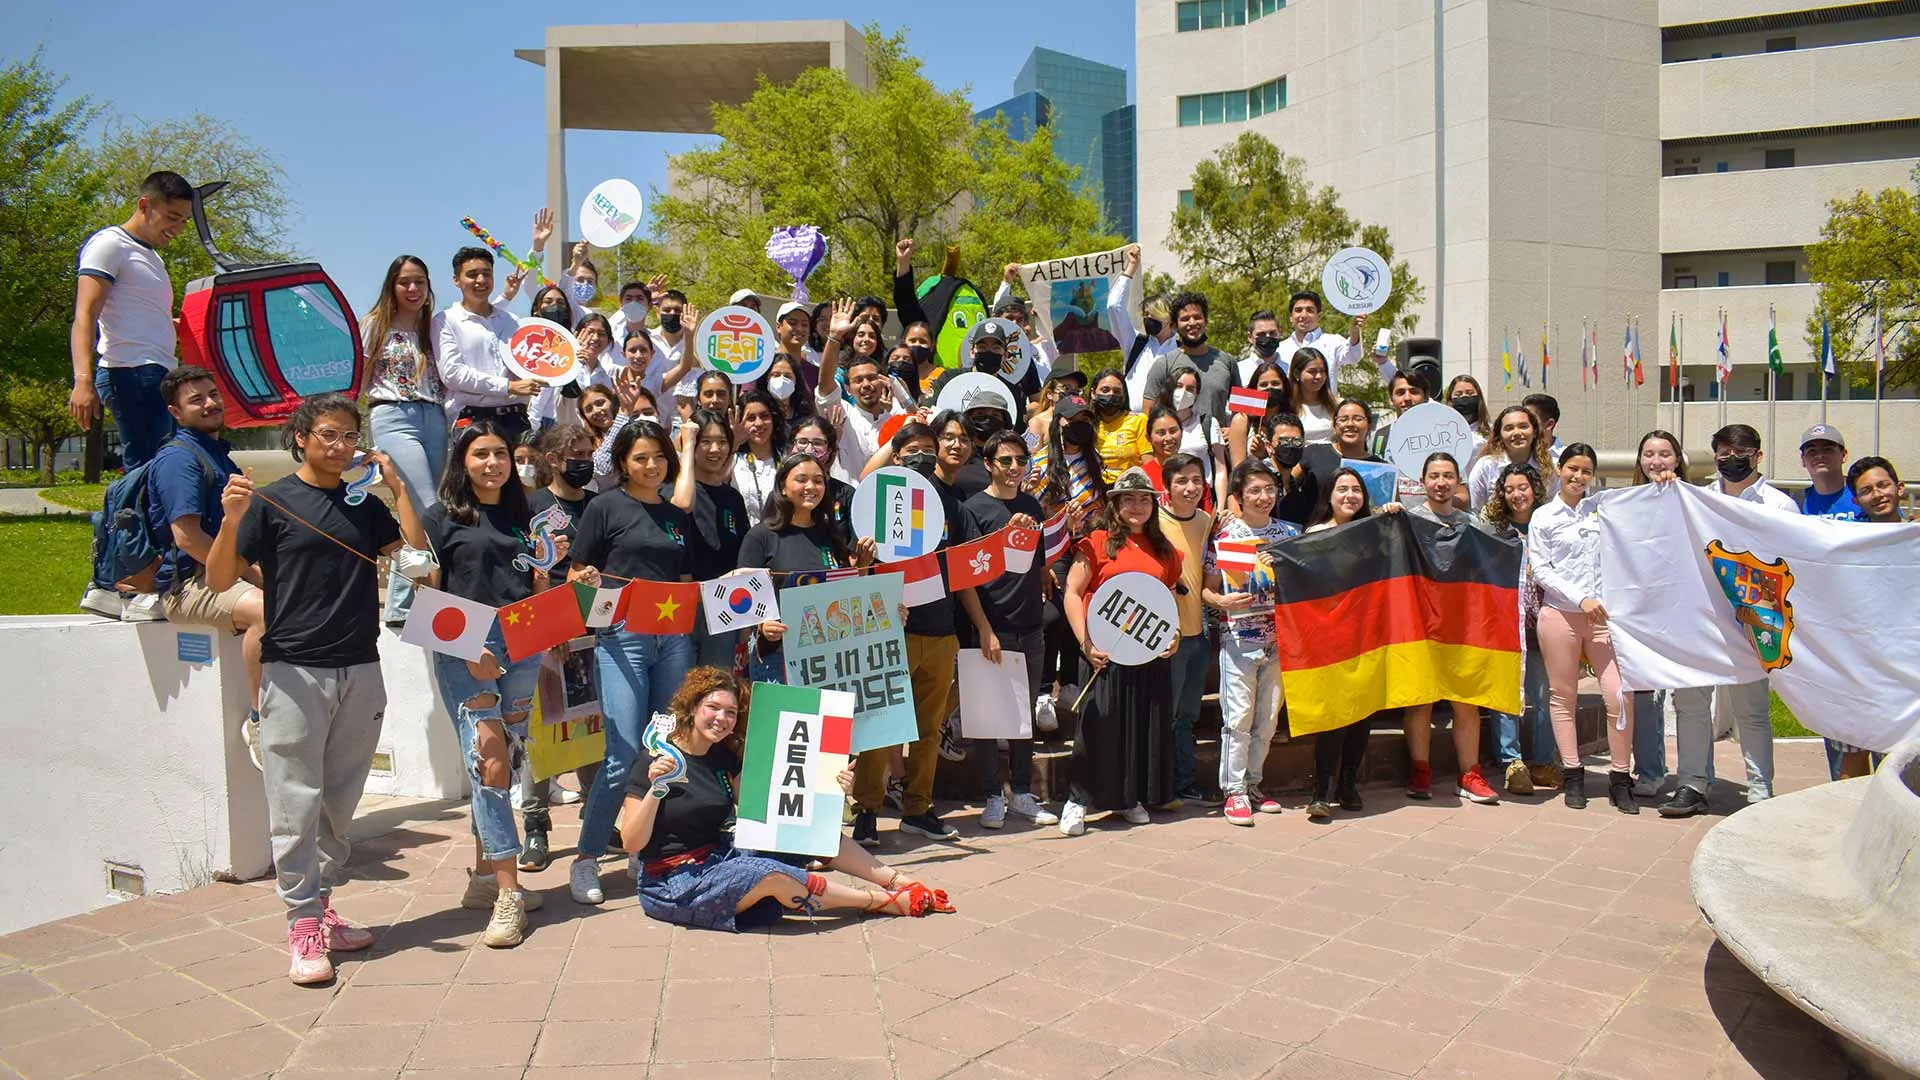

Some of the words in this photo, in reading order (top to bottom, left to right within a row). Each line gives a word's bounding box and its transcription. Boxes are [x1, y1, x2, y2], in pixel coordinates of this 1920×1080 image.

[1398, 431, 1452, 452] AEDUR
[893, 490, 904, 540] AEAM
[798, 592, 892, 648] ASIA
[1097, 589, 1171, 651] AEDEG
[835, 648, 860, 678] IN
[778, 720, 809, 817] AEAM
